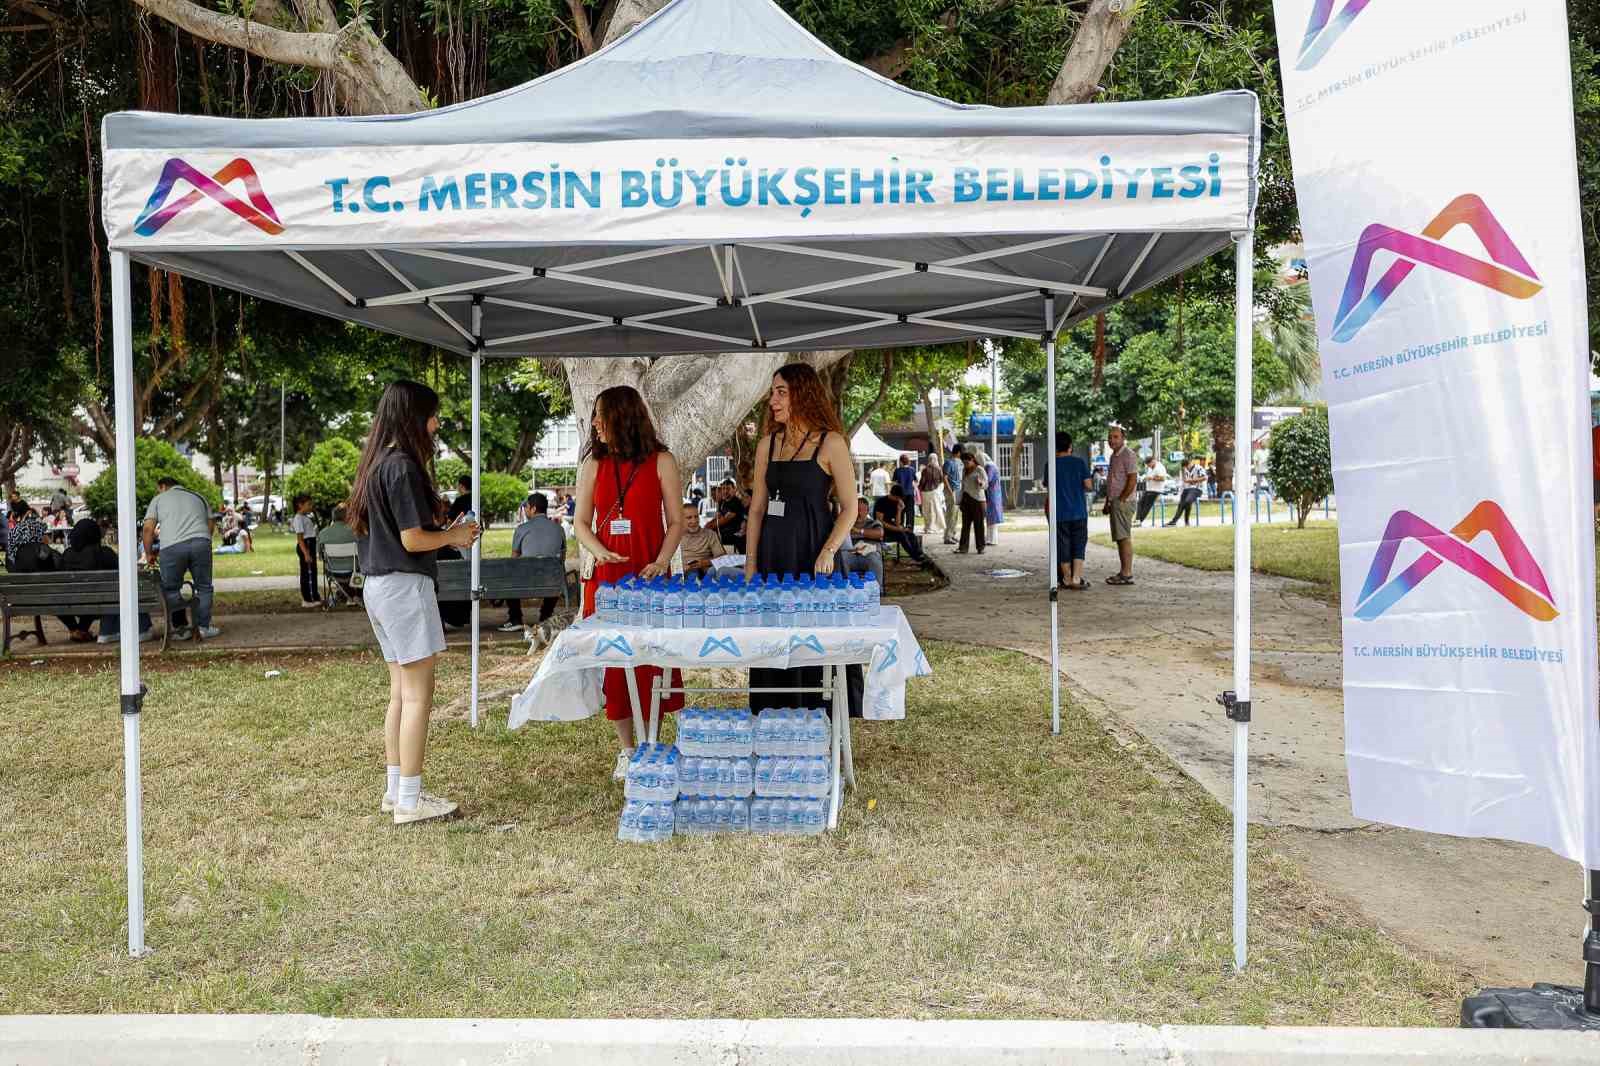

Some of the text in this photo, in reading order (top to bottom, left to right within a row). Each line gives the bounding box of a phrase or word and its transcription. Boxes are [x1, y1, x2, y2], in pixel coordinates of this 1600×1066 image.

[324, 152, 1222, 219] T.C. MERSİN BÜYÜKŞEHİR BELEDİYESİ
[1333, 320, 1548, 380] T.C. MERSİN BÜYÜKŞEHİR BELEDİYESİ
[1353, 643, 1563, 664] T.C. MERSİN BÜYÜKŞEHİR BELEDİYESİ
